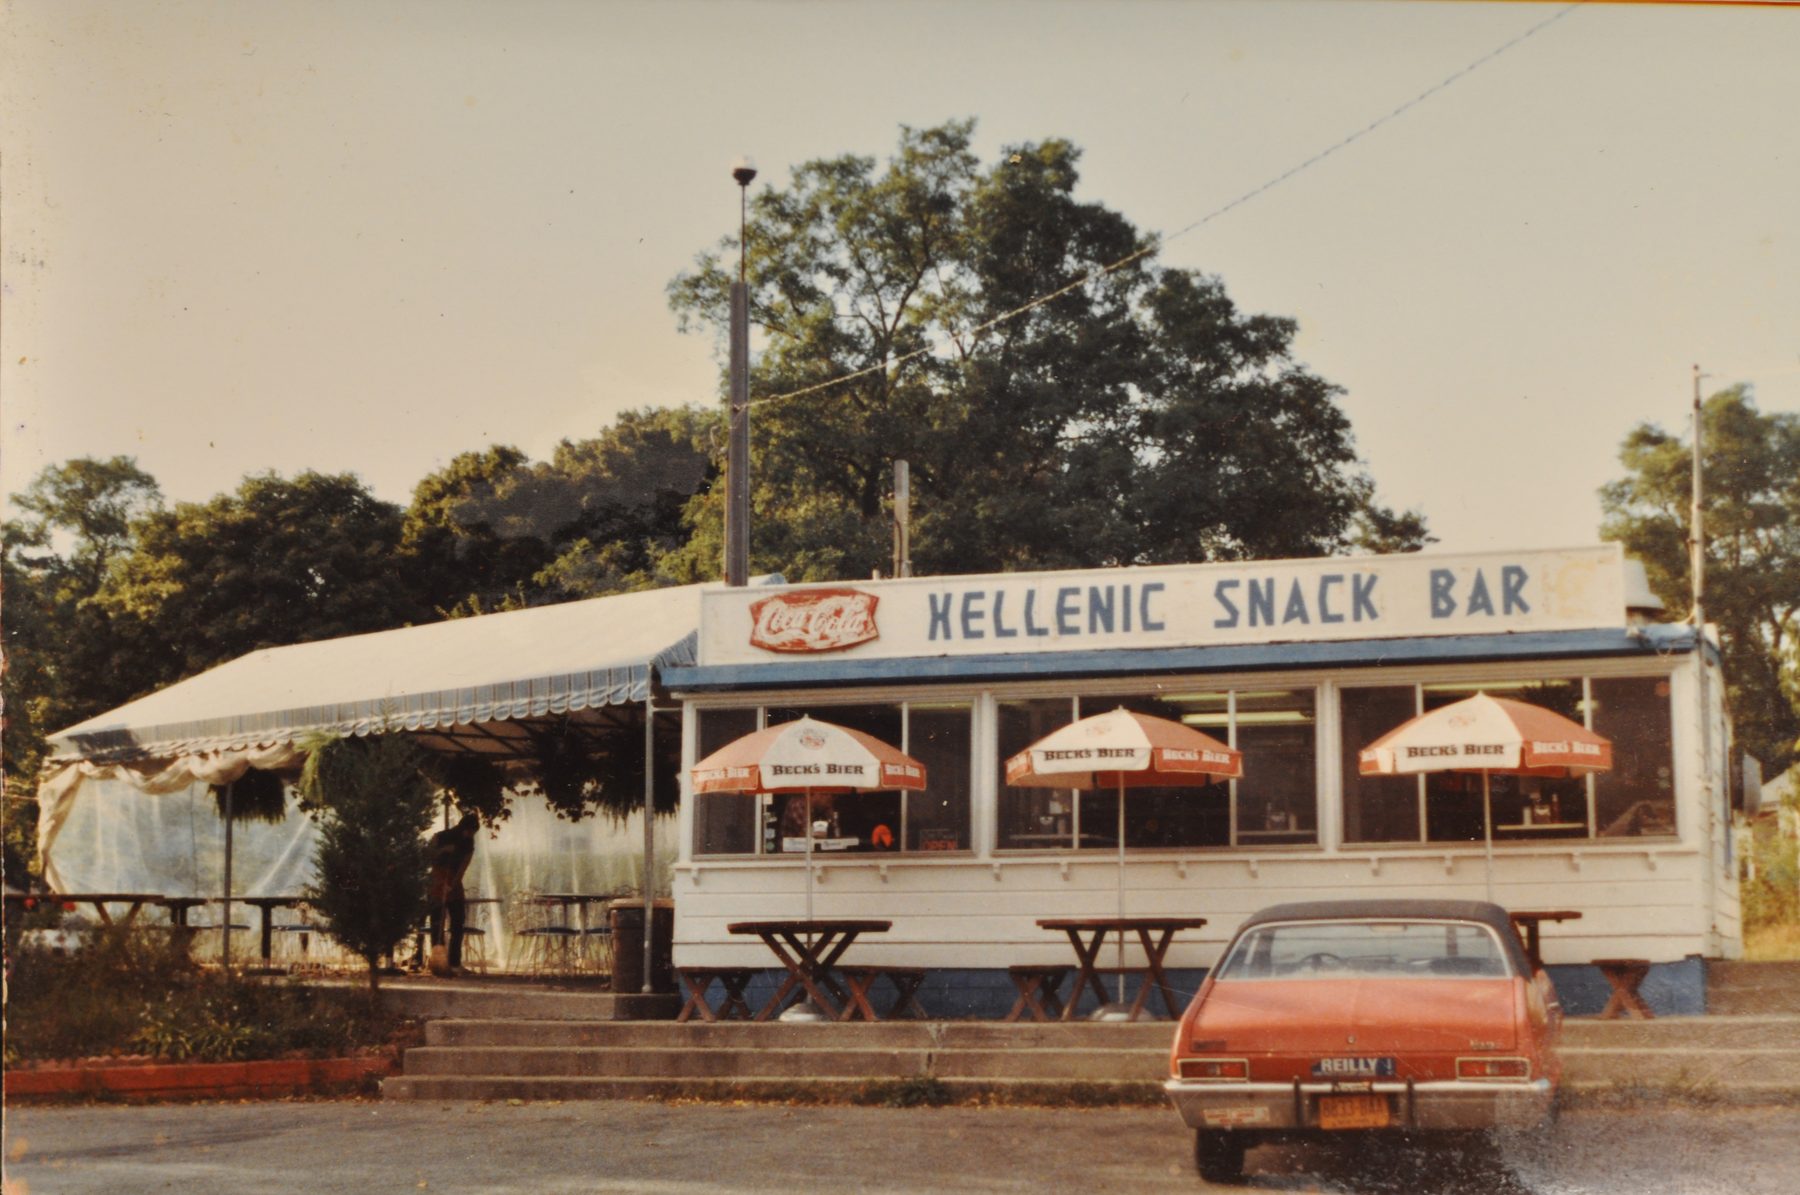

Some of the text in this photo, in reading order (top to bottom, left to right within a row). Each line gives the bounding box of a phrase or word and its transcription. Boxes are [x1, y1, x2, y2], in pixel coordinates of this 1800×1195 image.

[927, 565, 1531, 641] HELLENIC SNACK BAR
[1096, 747, 1136, 759] BIER
[1463, 743, 1505, 756] BIER
[825, 762, 865, 775] BIER
[1319, 1056, 1378, 1073] REILLY
